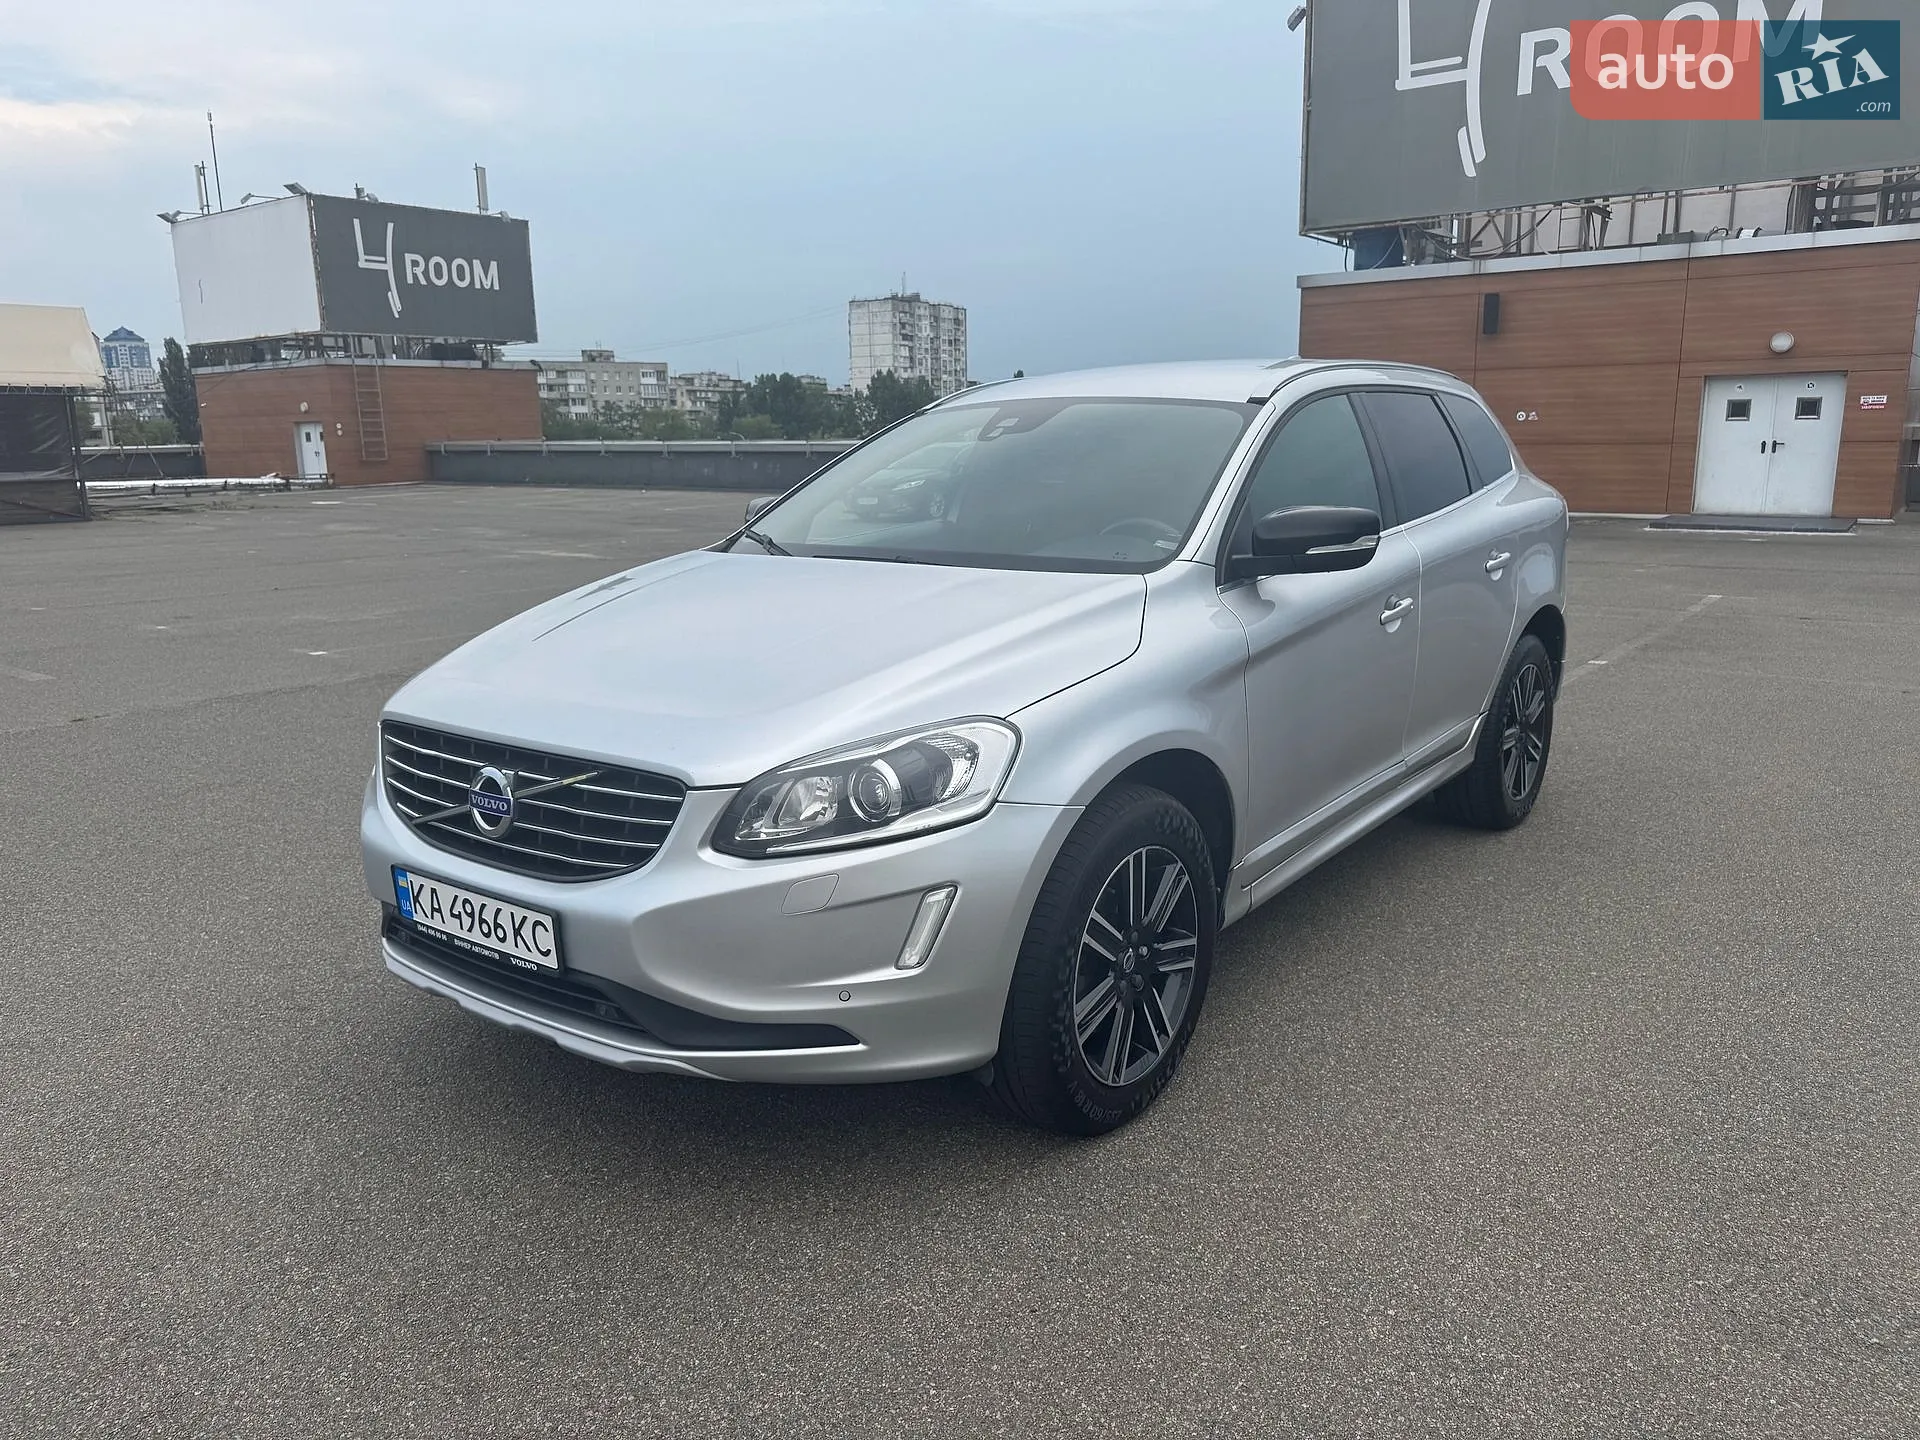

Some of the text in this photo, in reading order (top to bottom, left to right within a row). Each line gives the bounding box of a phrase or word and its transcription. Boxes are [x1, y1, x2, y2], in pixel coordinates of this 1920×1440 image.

[404, 253, 500, 291] ROOM
[470, 793, 508, 811] VOLVO
[401, 899, 412, 912] UA
[510, 957, 538, 971] VOLVO
